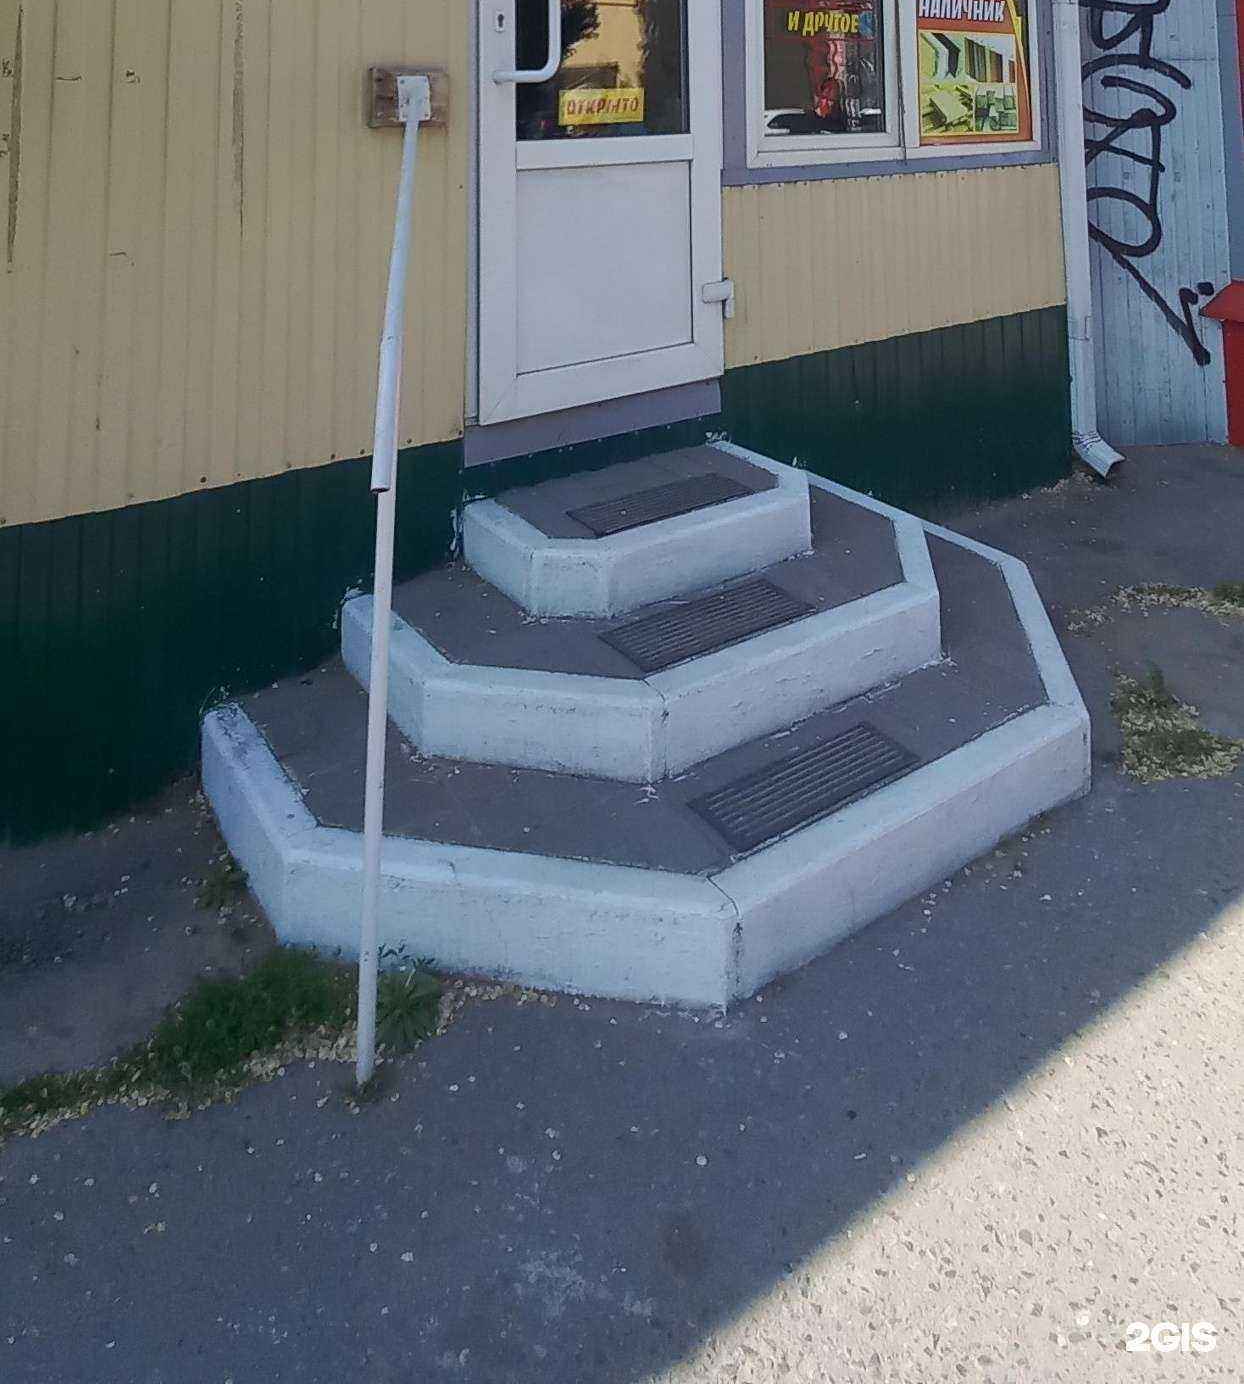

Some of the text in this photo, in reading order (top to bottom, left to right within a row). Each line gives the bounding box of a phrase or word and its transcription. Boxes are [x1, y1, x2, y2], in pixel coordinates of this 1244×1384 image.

[787, 10, 860, 36] И ДРУГОЕ
[567, 97, 640, 115] ОТКРЫТО
